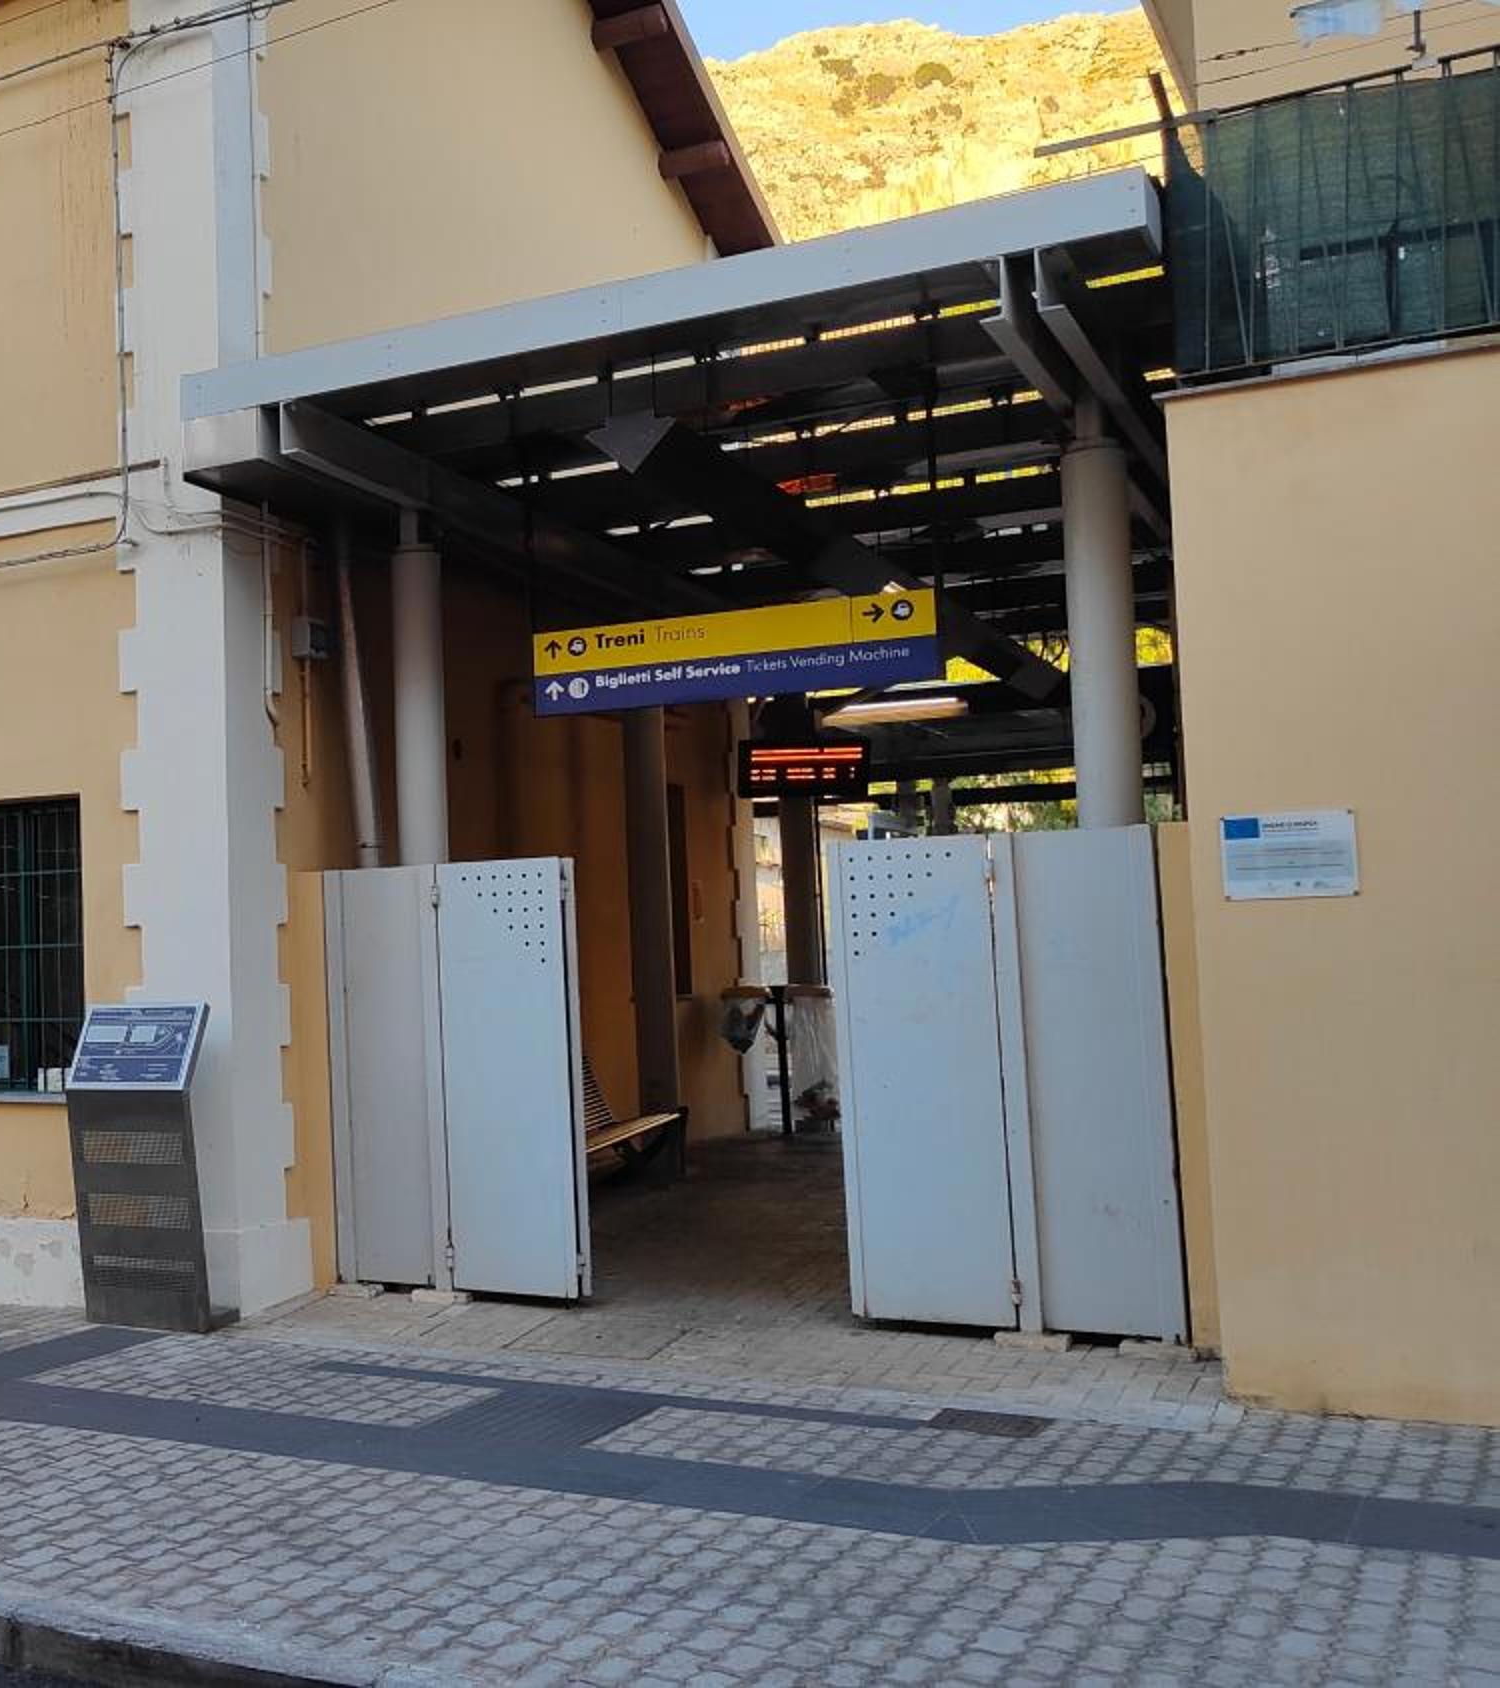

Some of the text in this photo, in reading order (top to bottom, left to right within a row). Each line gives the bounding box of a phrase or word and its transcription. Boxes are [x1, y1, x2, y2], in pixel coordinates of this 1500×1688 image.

[595, 625, 706, 649] Treni Trains
[595, 644, 910, 690] Biglietti Self Service Tickets Vending Machine
